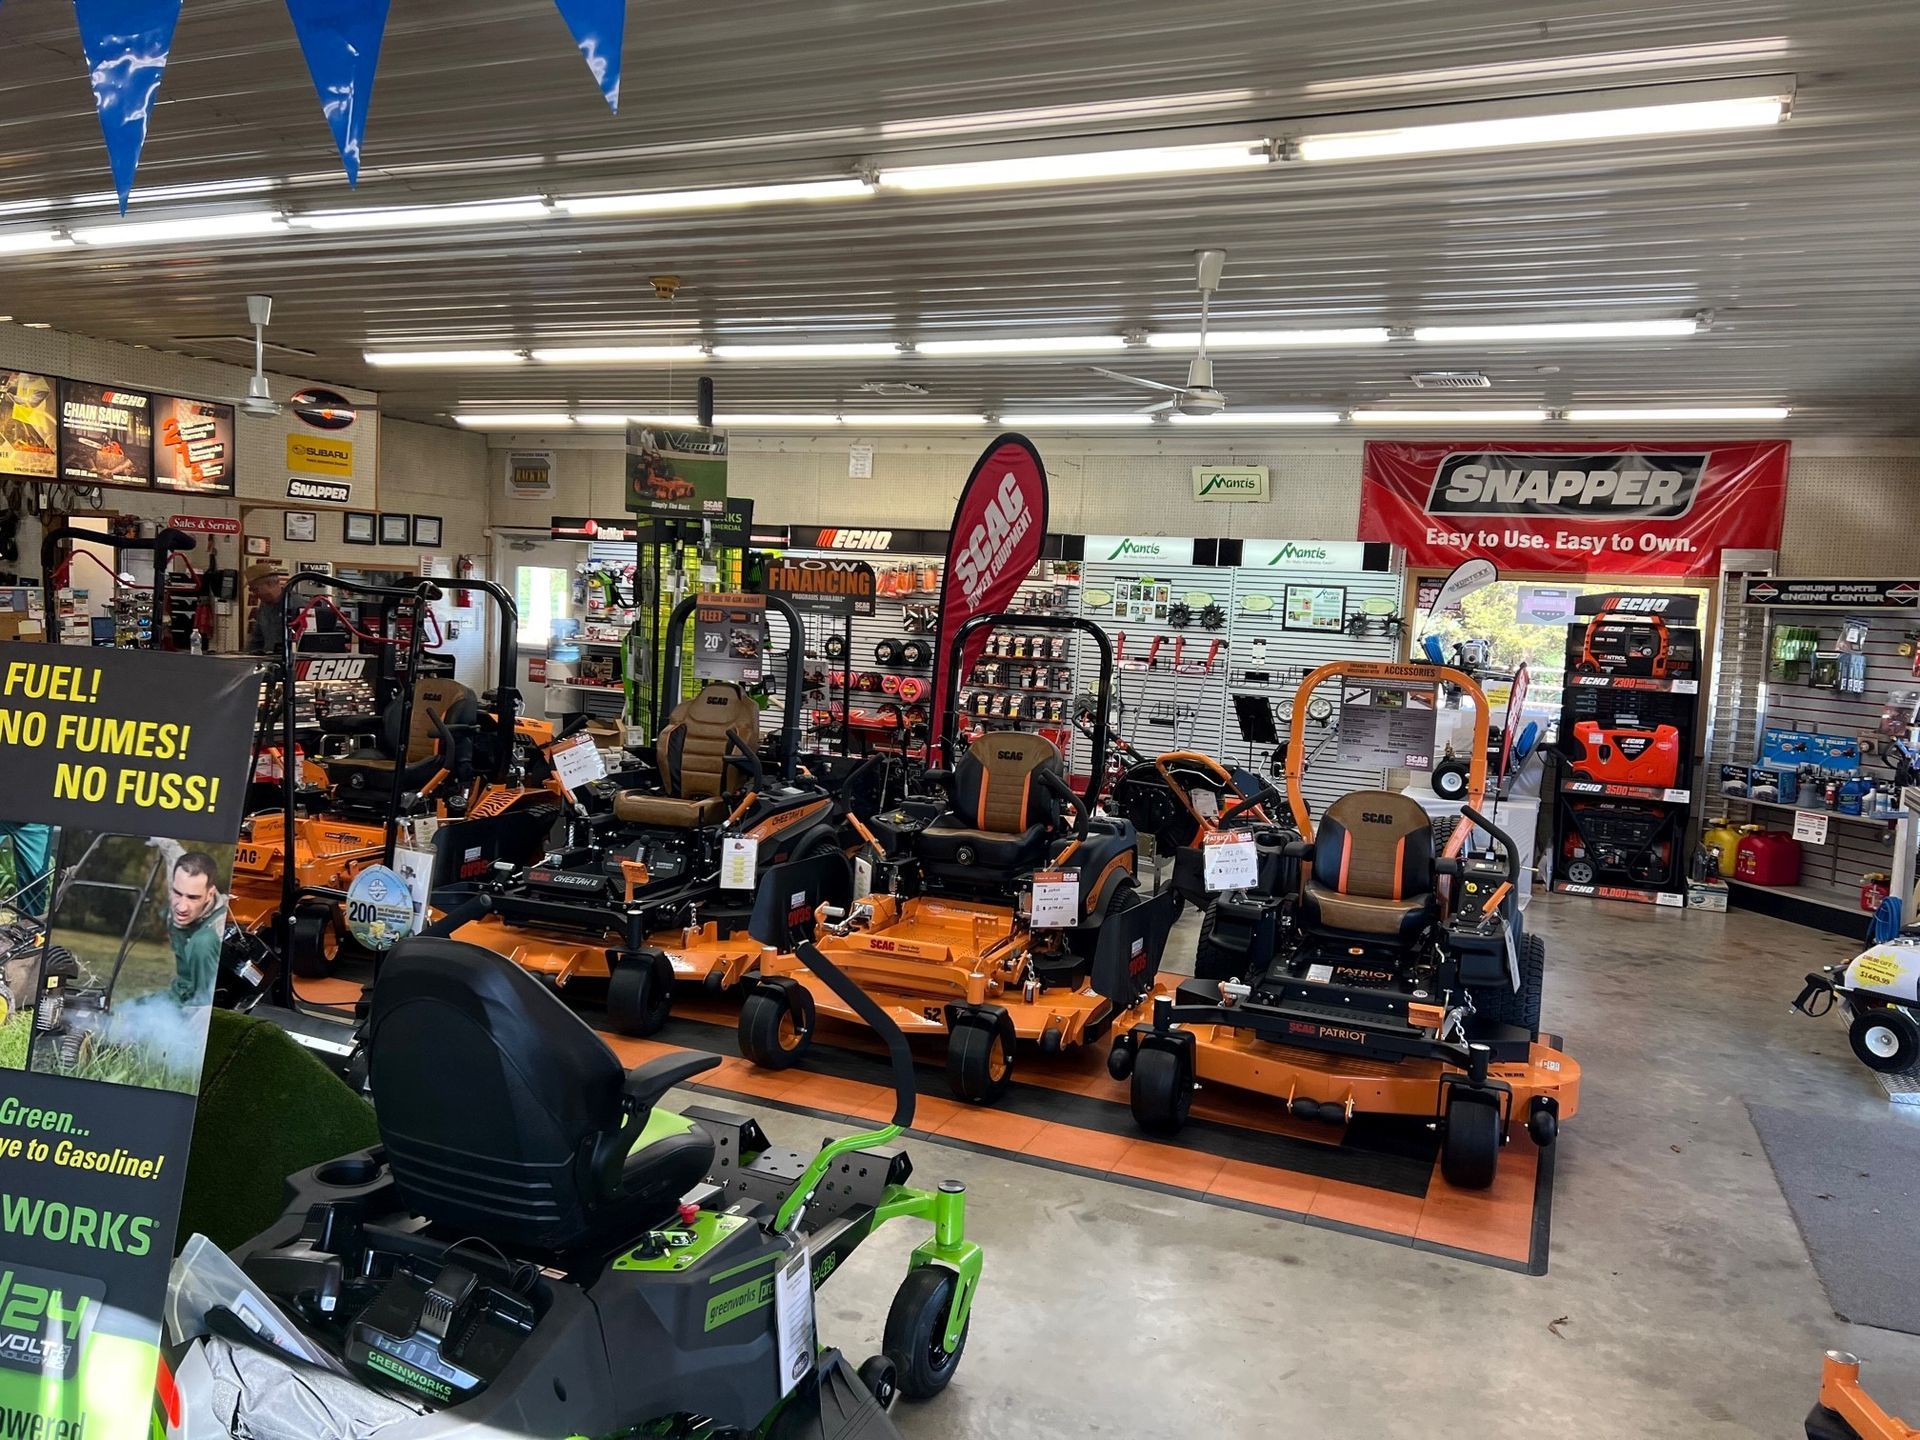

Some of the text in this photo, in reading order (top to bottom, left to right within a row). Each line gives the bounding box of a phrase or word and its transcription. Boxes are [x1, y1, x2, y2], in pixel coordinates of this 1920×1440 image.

[112, 393, 147, 407] ECHO
[64, 402, 98, 420] CHAIN
[99, 406, 129, 425] SAWS
[306, 447, 349, 460] SUBARU
[289, 481, 348, 500] SNAPPER
[1198, 473, 1255, 496] Mantis
[1445, 464, 1683, 505] SNAPPER
[703, 500, 723, 508] SCAG
[173, 517, 237, 531] Sales & Service
[954, 471, 1024, 595] SCAG
[831, 529, 893, 550] ECHO
[1425, 528, 1698, 555] Easy to Use. Easy to Own.
[1107, 538, 1160, 561] Mantis
[1267, 542, 1327, 566] Mantis
[784, 559, 858, 572] LOW
[966, 505, 1033, 614] POWER EQUIPMENT
[768, 566, 870, 596] FINANCING
[1788, 584, 1877, 593] GENUINE PARTS
[1419, 588, 1439, 602] SC
[1616, 597, 1670, 612] ECHO
[1780, 593, 1885, 603] ENGINE CENTER
[305, 659, 366, 680] ECHO
[1384, 665, 1436, 677] ACCESSORIES
[3, 661, 103, 703] FUEL!
[1580, 676, 1610, 686] ECHO
[1612, 677, 1636, 688] 2300
[0, 708, 191, 760] NO FUMES!
[997, 750, 1023, 761] SCAG
[1406, 755, 1429, 764] SCAG
[53, 763, 220, 813] NO FUSS!
[1572, 782, 1602, 792] ECHO
[1605, 784, 1629, 795] 3500
[1362, 812, 1393, 825] SCAG
[553, 876, 592, 886] CHEETAH
[1565, 883, 1595, 894] ECHO
[1597, 886, 1628, 899] 10,000
[349, 901, 377, 923] 200
[870, 939, 895, 951] SCAG
[1336, 966, 1394, 981] PATRIOT
[1319, 1026, 1367, 1045] PATRIOT
[0, 1097, 90, 1136] Green...
[27, 1139, 49, 1162] to
[54, 1140, 165, 1180] Gasoline!
[709, 1287, 756, 1324] greenworks
[368, 1351, 453, 1396] GREENWORKS
[404, 1379, 450, 1403] COMMERCIAL
